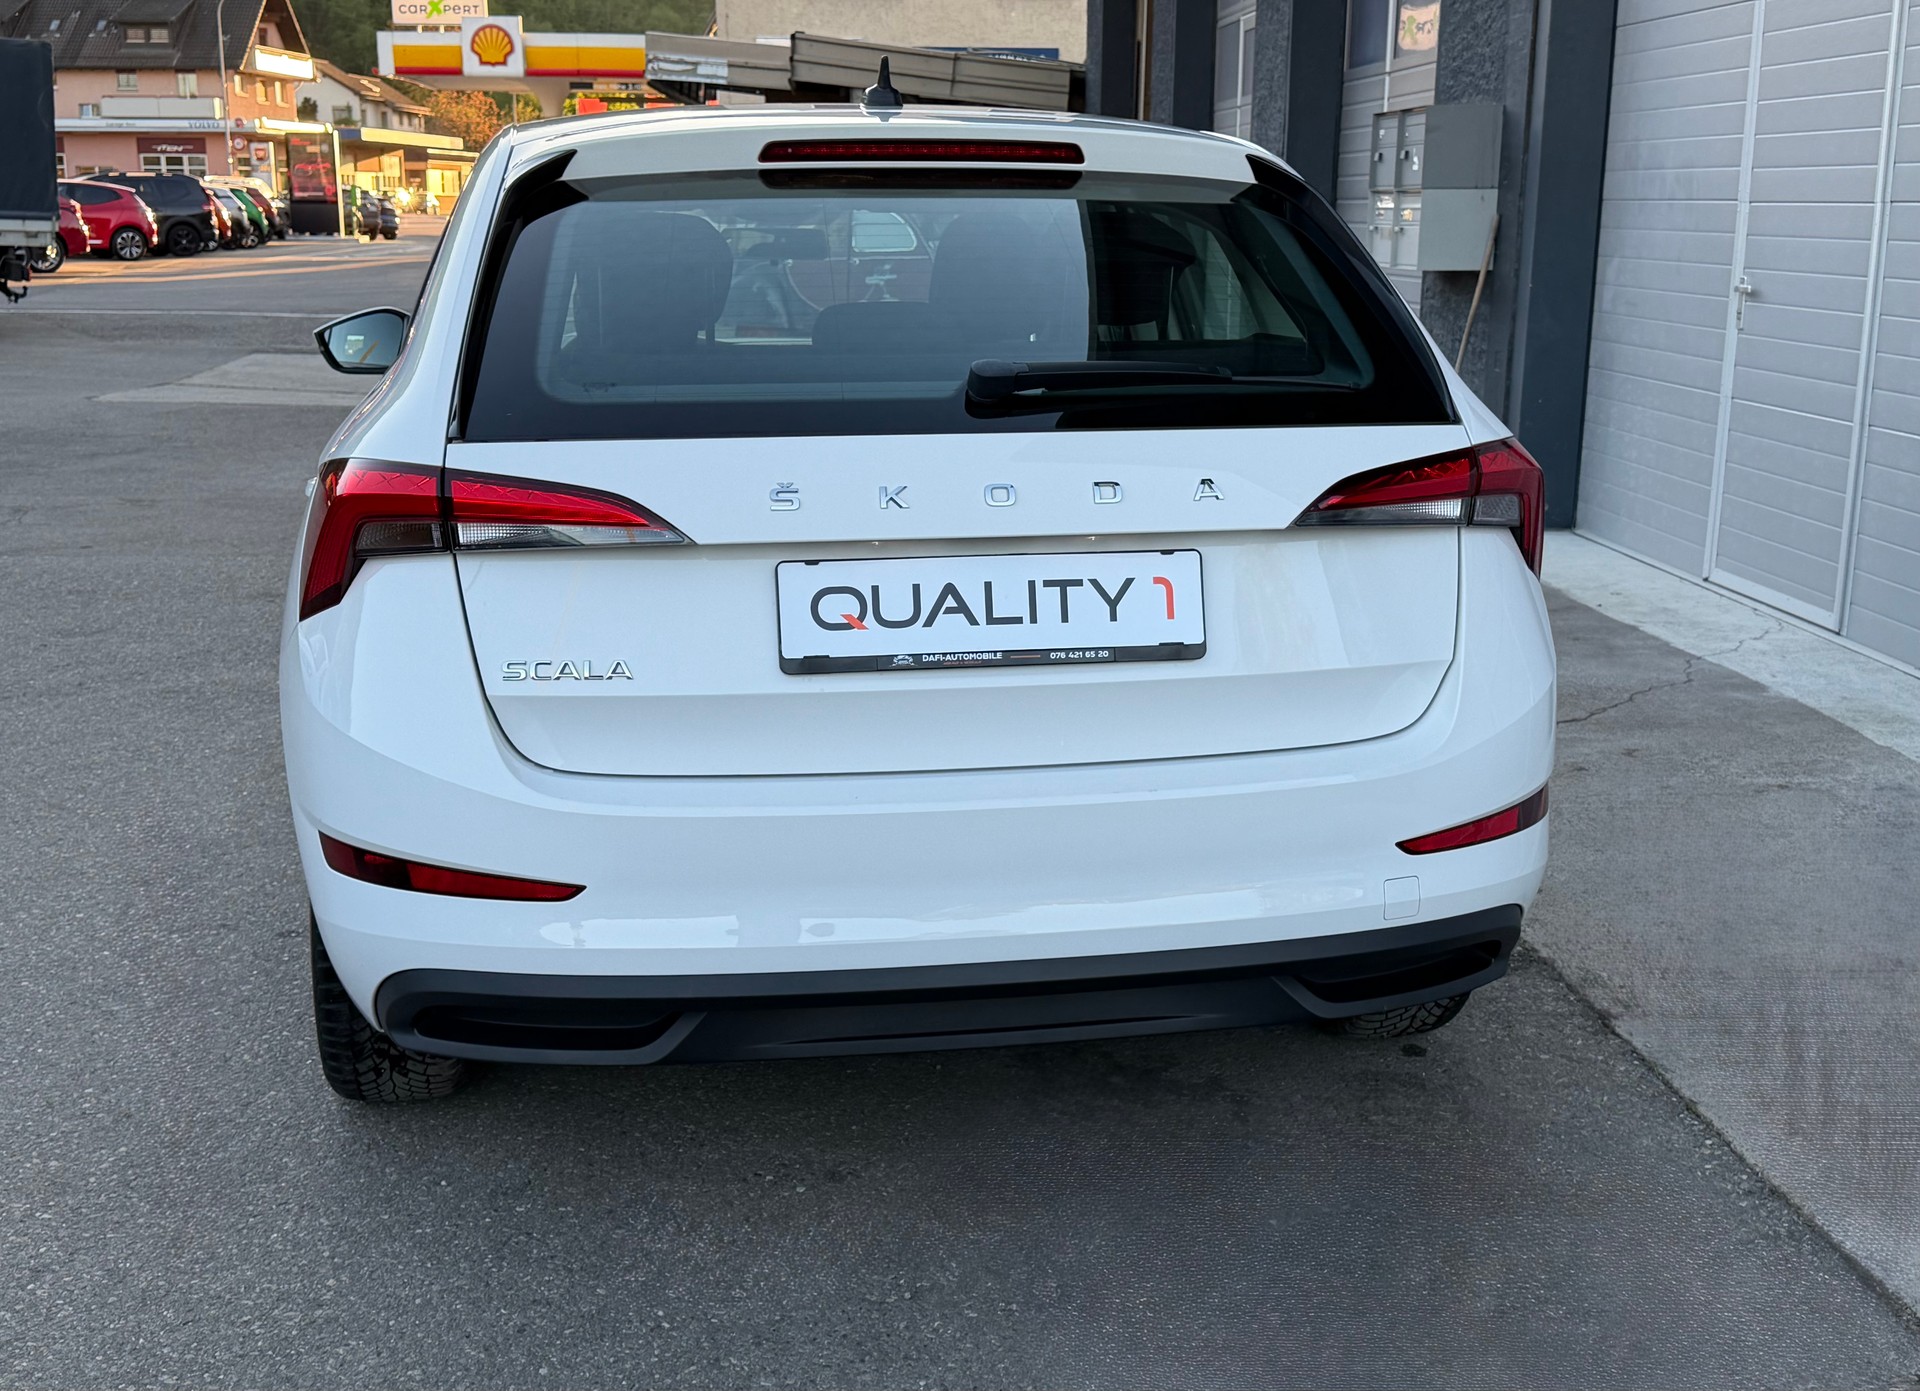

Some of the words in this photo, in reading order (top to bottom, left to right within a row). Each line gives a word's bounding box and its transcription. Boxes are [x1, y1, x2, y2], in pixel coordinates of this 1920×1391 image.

[188, 121, 220, 129] VOLVO
[810, 577, 1136, 631] QUALITY
[1152, 576, 1175, 620] 1
[922, 652, 1003, 662] DAFI-AUTOMOBILE
[1050, 651, 1066, 659] 076
[1068, 651, 1083, 659] 421
[1097, 650, 1109, 658] 20
[502, 659, 634, 682] SCALA
